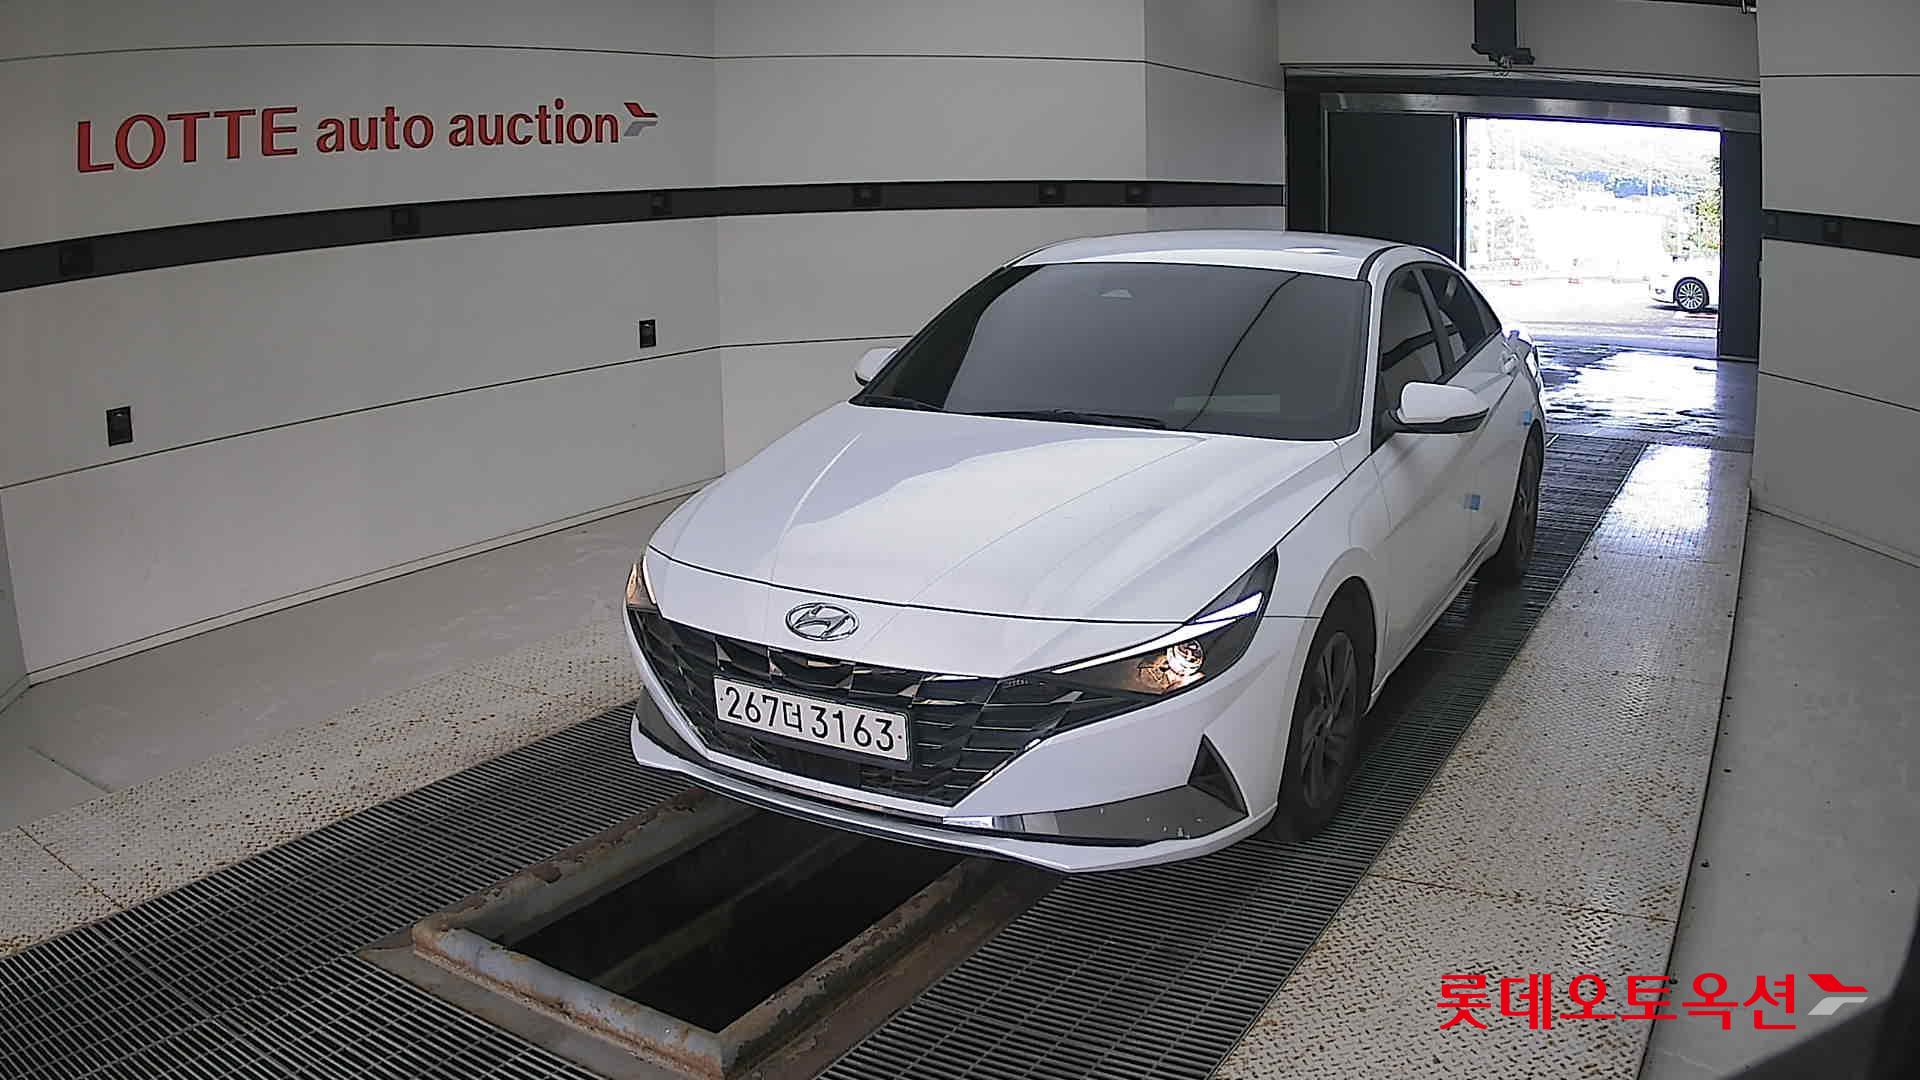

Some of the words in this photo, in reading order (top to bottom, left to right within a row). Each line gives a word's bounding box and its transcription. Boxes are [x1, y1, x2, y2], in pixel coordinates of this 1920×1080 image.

[77, 106, 298, 173] LOTTE
[316, 106, 434, 153] auto
[448, 98, 620, 147] auction
